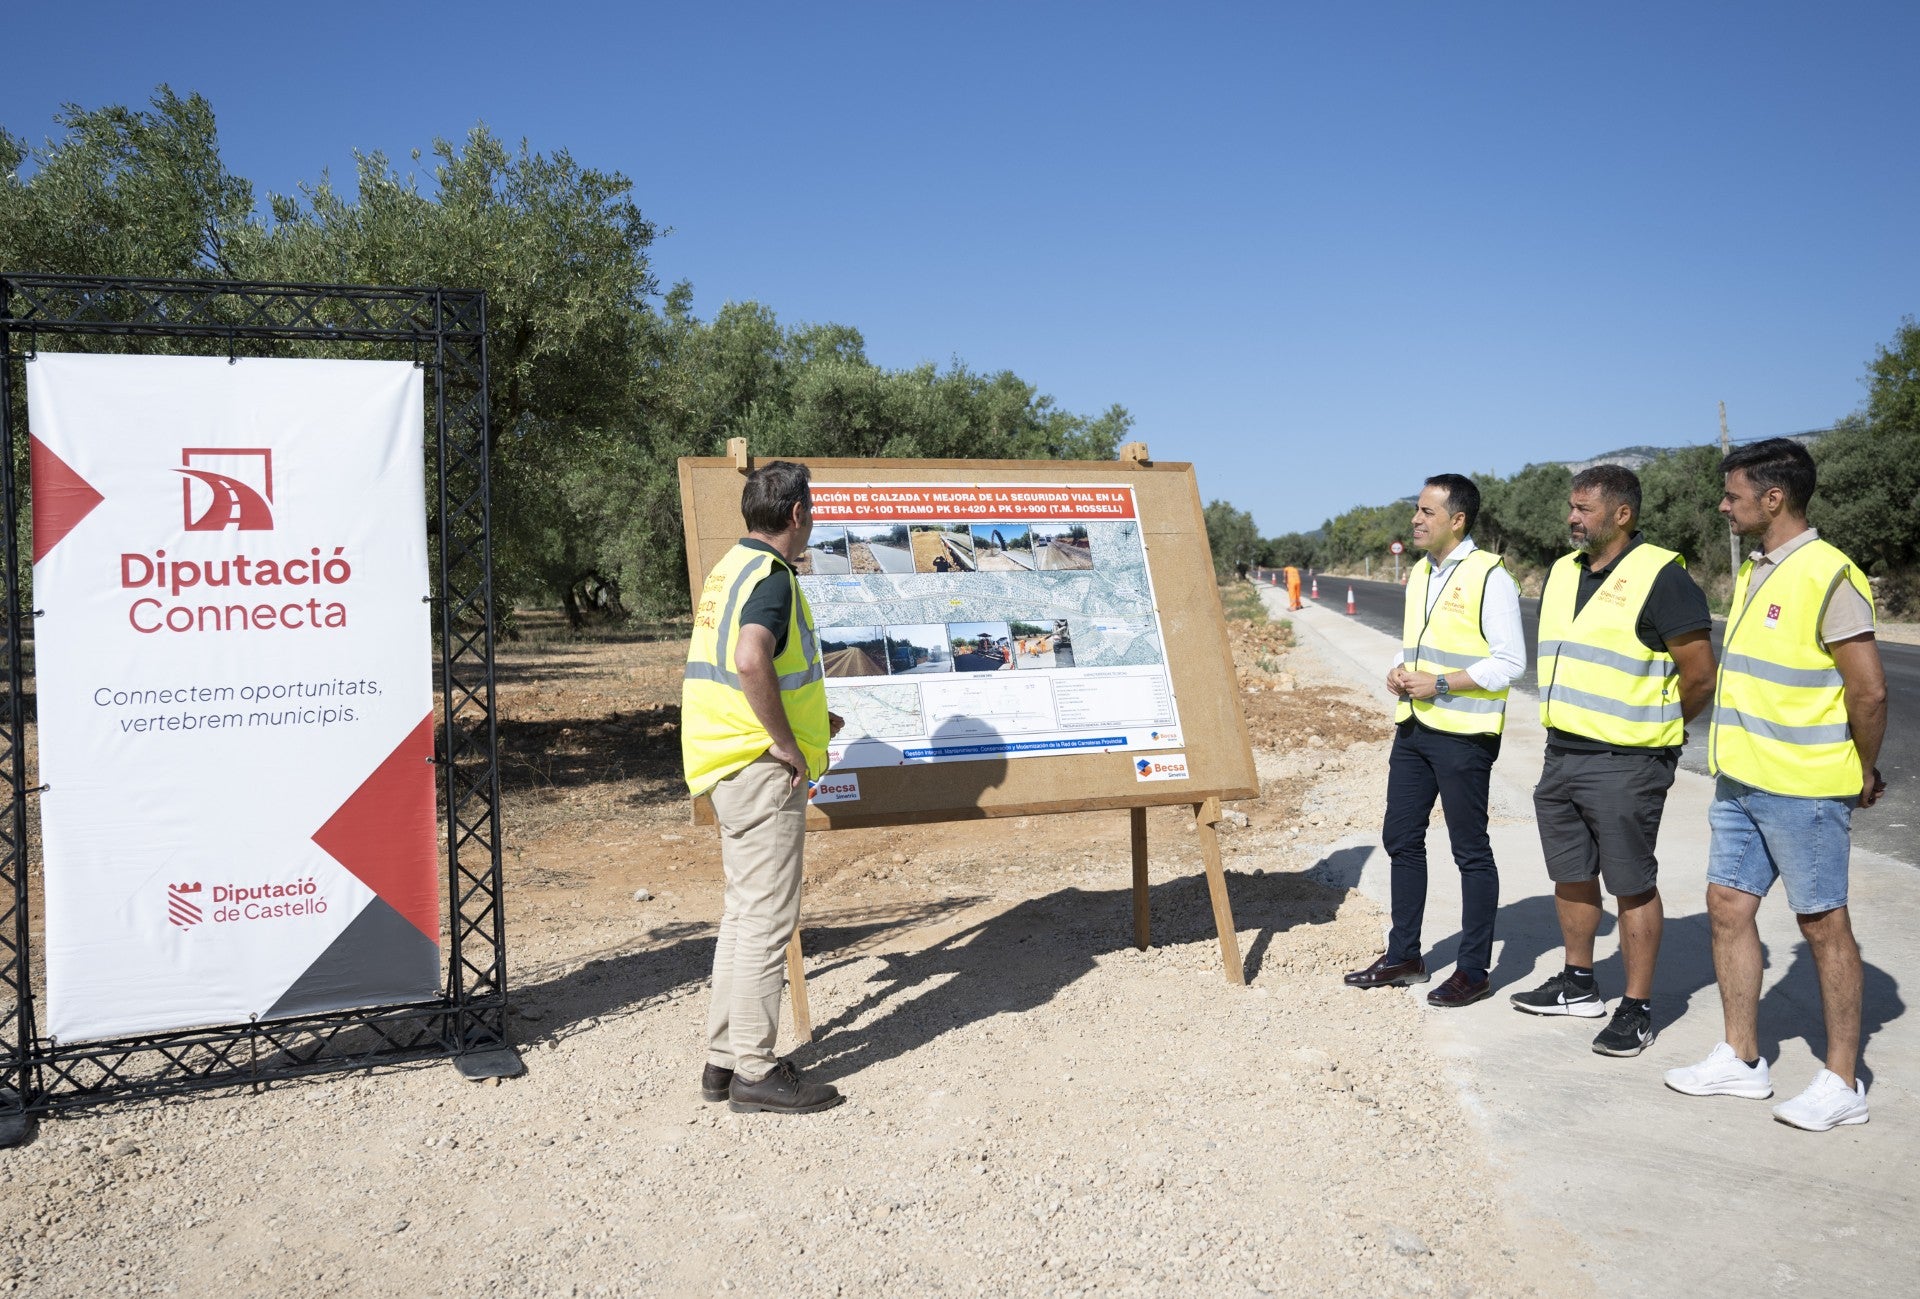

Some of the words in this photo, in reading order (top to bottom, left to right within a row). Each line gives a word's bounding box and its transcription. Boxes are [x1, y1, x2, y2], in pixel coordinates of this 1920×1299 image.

[853, 493, 868, 502] DE
[871, 493, 920, 502] CALZADA
[922, 493, 930, 502] Y
[932, 493, 975, 502] MEJORA
[978, 493, 993, 502] DE
[995, 493, 1009, 502] LA
[1010, 493, 1069, 502] SEGURIDAD
[1071, 493, 1094, 502] VIAL
[1096, 493, 1110, 502] EN
[1111, 493, 1125, 502] LA
[855, 505, 894, 514] CV-100
[896, 505, 934, 514] TRAMO
[936, 505, 951, 514] PK
[953, 505, 986, 514] 8+420
[988, 505, 997, 513] A
[998, 505, 1013, 513] PK
[1015, 505, 1047, 513] 9+900
[1049, 505, 1074, 514] (T.M.
[1075, 505, 1123, 514] ROSSELL)
[120, 546, 351, 596] Diputació
[129, 598, 347, 633] Connecta
[94, 685, 235, 706] Connectem
[240, 679, 383, 703] oportunitats,
[120, 711, 243, 733] vertebrem
[248, 704, 360, 727] municipis.
[1016, 741, 1048, 750] Modernización
[1154, 763, 1184, 772] Becsa
[820, 784, 856, 794] Becsa
[213, 877, 317, 904] Diputació
[214, 906, 240, 922] de
[244, 896, 327, 920] Castelló
